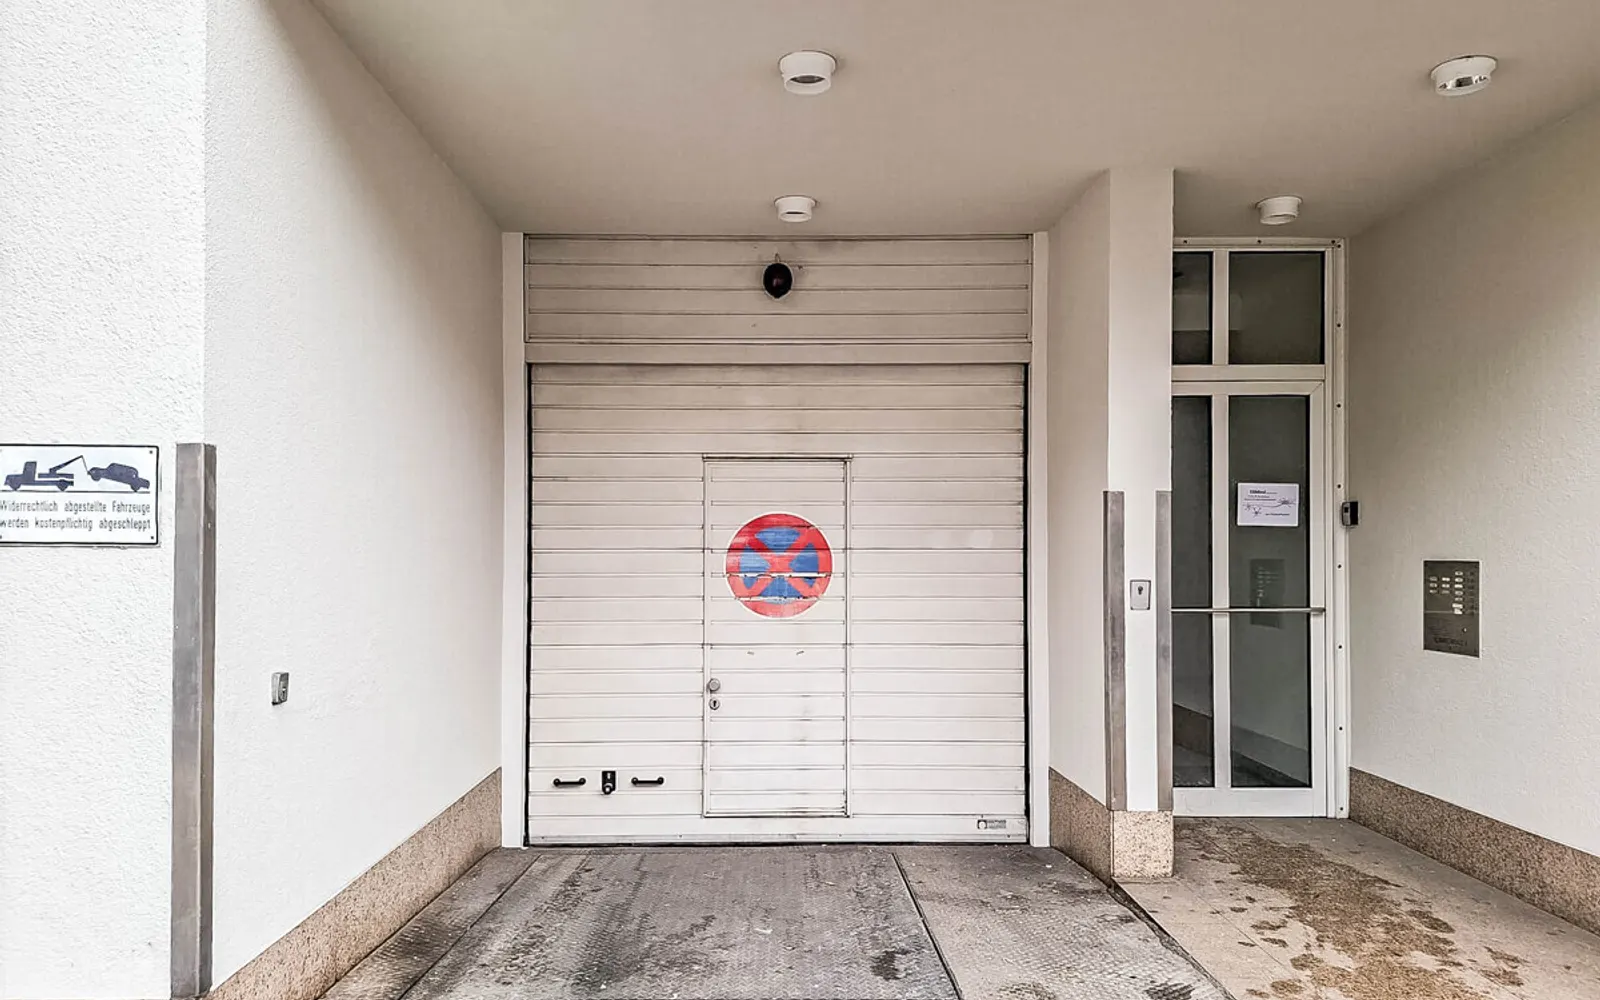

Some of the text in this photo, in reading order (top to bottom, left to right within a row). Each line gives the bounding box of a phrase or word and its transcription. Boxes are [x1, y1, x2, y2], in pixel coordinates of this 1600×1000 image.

[64, 500, 107, 514] abgestellte
[112, 500, 150, 515] Fahrzeuge
[0, 518, 151, 531] werden kostenpflichtig abgeschleppt
